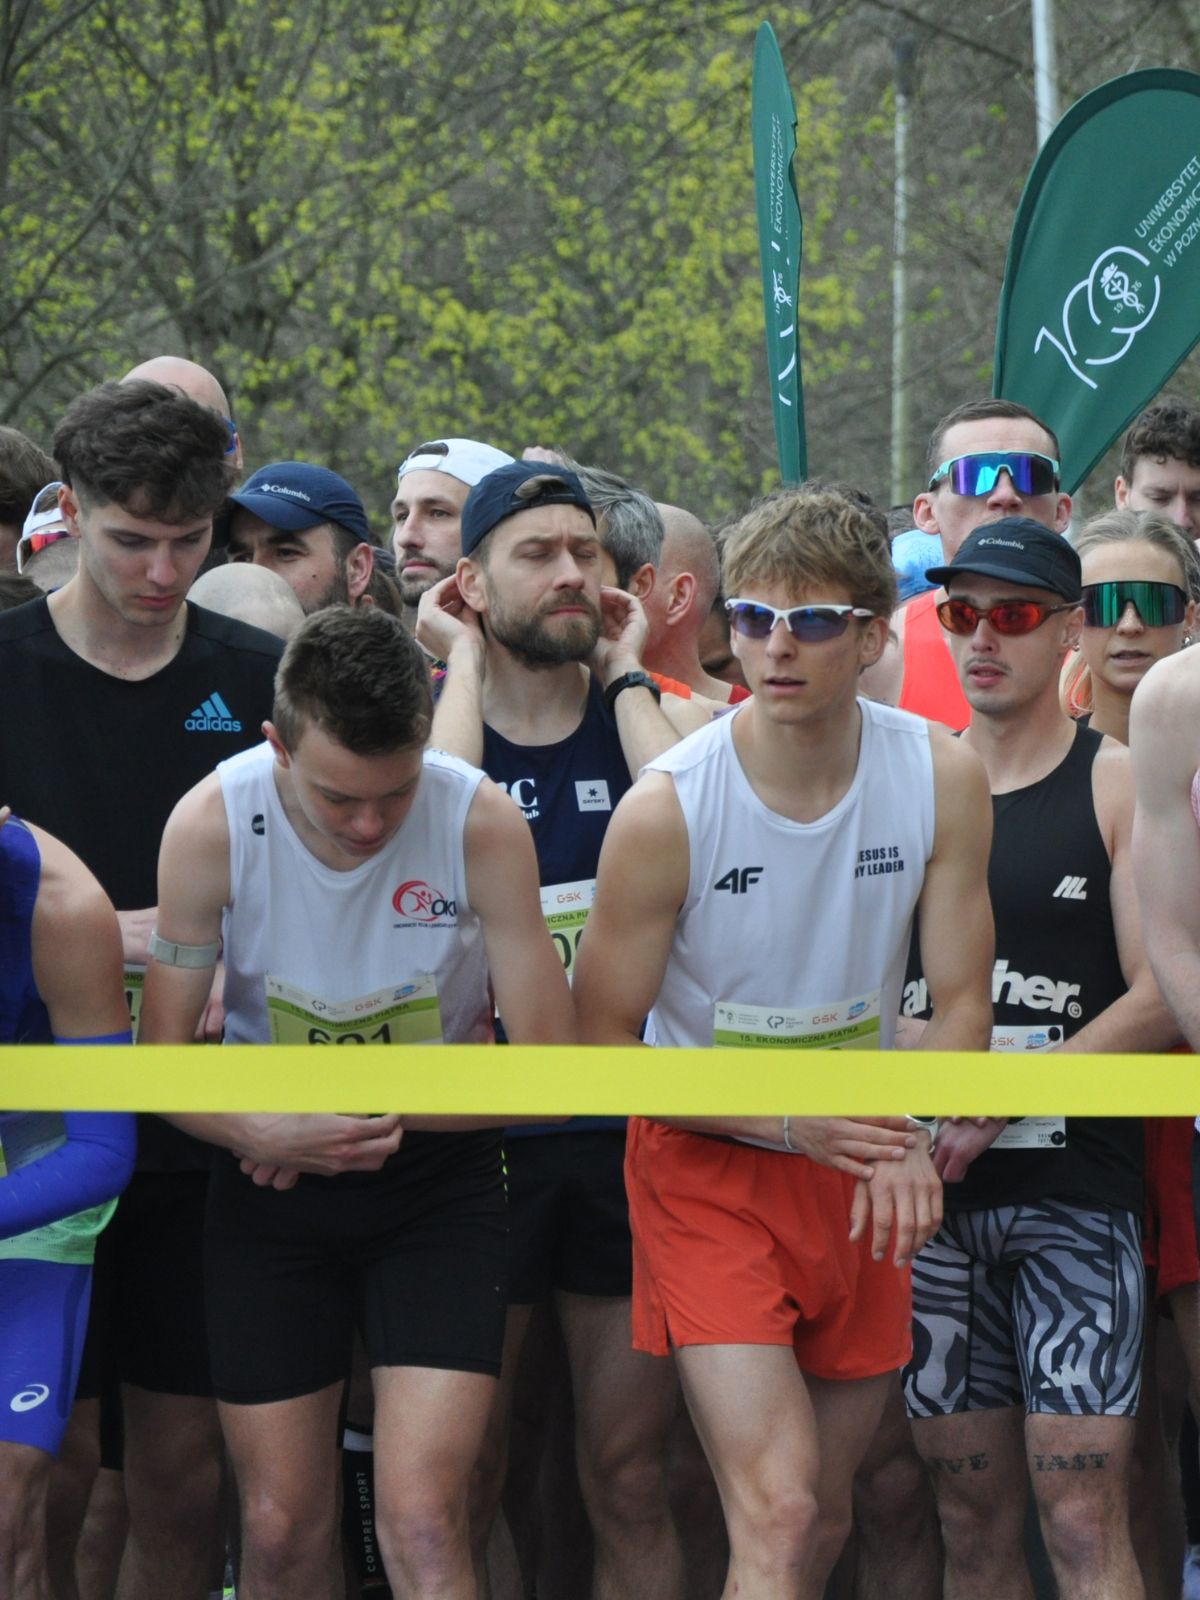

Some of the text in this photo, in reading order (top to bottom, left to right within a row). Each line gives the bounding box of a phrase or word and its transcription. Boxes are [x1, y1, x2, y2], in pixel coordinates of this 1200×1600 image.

[1163, 251, 1178, 268] W
[1131, 280, 1143, 293] 26
[1113, 302, 1125, 315] 19
[270, 484, 311, 502] Columbia
[986, 537, 1025, 550] Columbia
[184, 716, 242, 732] adidas
[522, 810, 540, 820] lub
[857, 846, 899, 863] ESUS IS
[867, 860, 904, 876] LEADER
[714, 866, 764, 894] 4F
[556, 892, 582, 904] GSK
[545, 911, 575, 924] ICZNA
[812, 1013, 839, 1026] GSK
[756, 1033, 827, 1045] EKONOMICZNA
[828, 1025, 860, 1040] PIĄTKA
